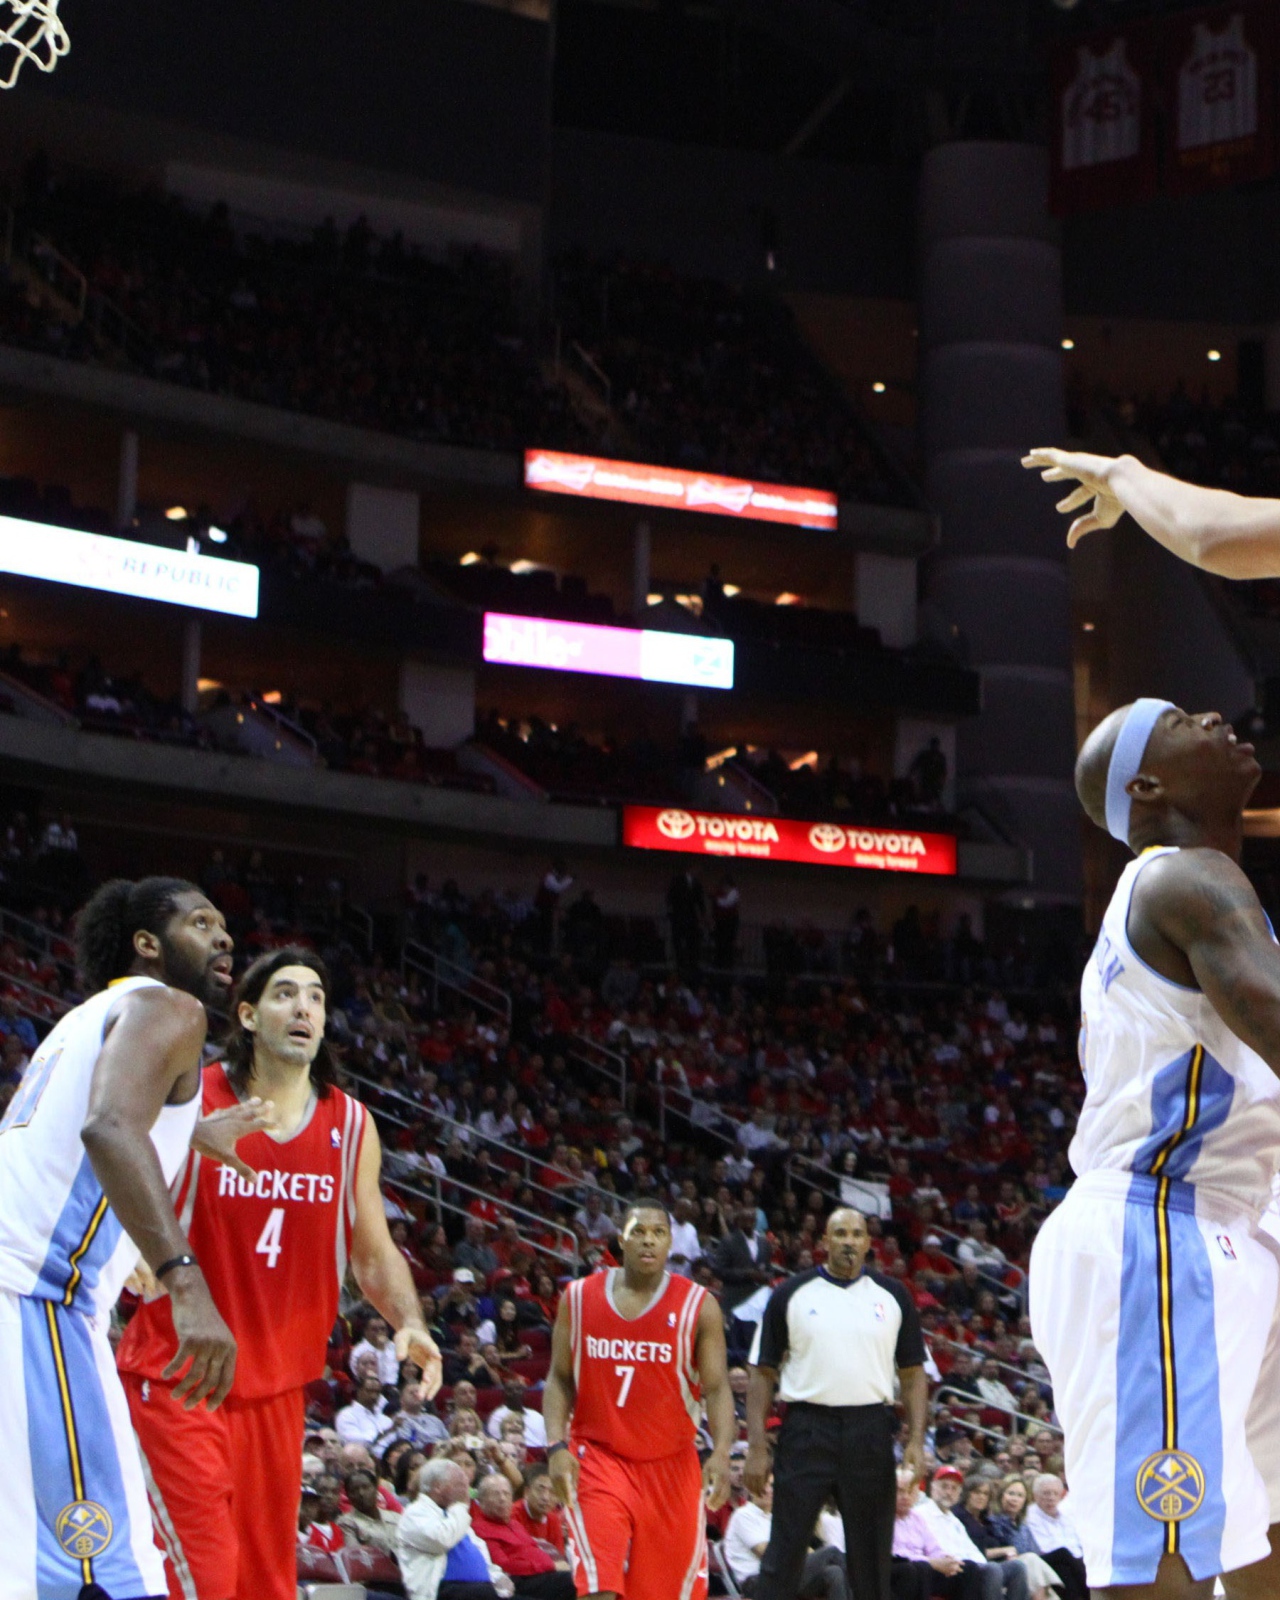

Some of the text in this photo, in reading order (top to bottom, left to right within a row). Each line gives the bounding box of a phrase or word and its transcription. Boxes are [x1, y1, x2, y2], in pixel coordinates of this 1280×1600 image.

[697, 816, 779, 842] TOYOTA
[848, 830, 926, 855] TOYOTA
[216, 1163, 334, 1203] ROCKETS
[256, 1208, 285, 1268] 4
[586, 1335, 672, 1363] ROCKETS
[615, 1365, 635, 1408] 7
